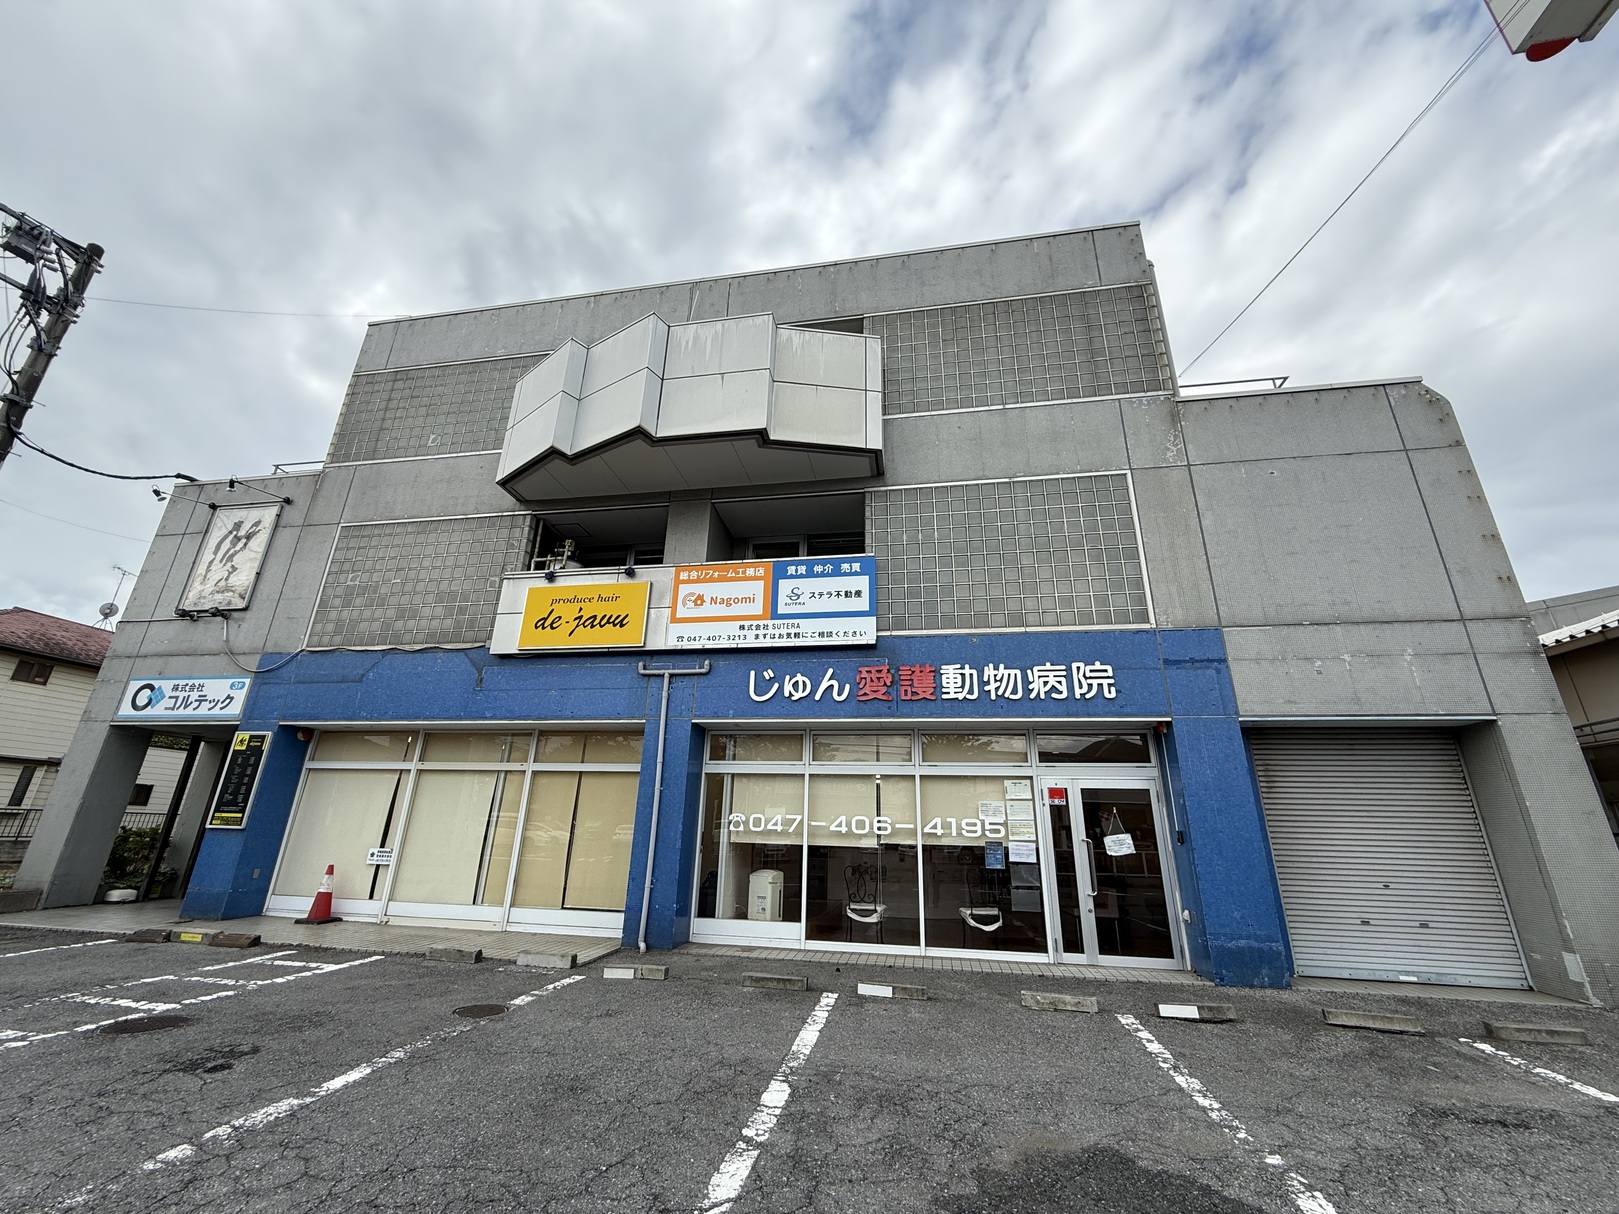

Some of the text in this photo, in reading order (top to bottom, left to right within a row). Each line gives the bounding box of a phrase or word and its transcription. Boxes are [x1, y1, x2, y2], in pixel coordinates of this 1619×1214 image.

[679, 567, 765, 580] 総合リフォーム工務店
[813, 563, 834, 574] 仲介
[840, 562, 861, 573] 売買
[550, 593, 621, 607] produce hair
[709, 593, 756, 607] Nagomi
[808, 589, 863, 600] ステラ不動産
[738, 622, 801, 632] 株式会社 SUTERA
[753, 630, 867, 640] まずはお気軽にご相談ください
[231, 681, 243, 690] 3F
[748, 660, 1118, 702] じゅん愛護動物病院
[171, 682, 205, 693] 株式会社
[164, 693, 235, 712] コルテック
